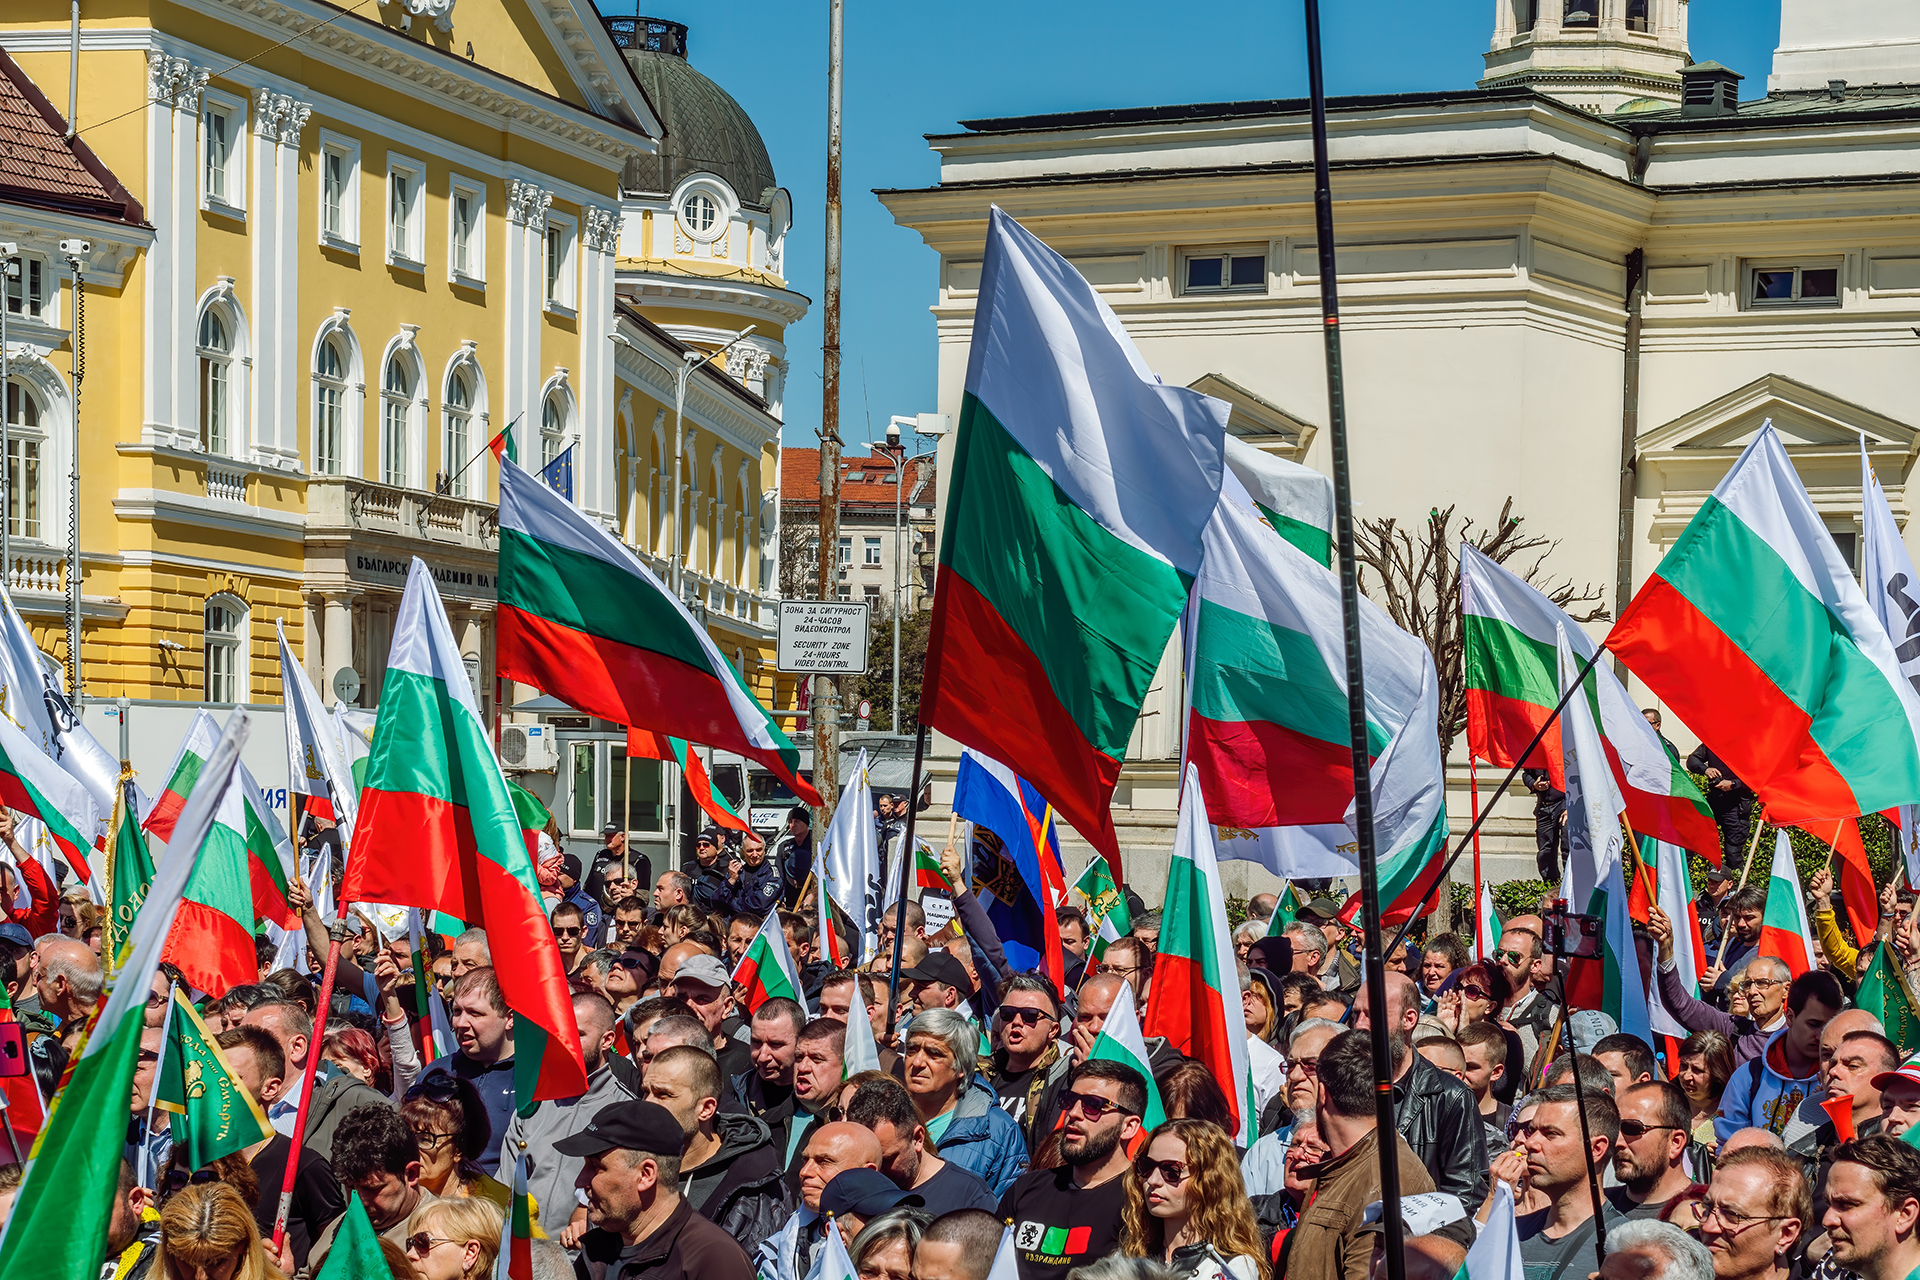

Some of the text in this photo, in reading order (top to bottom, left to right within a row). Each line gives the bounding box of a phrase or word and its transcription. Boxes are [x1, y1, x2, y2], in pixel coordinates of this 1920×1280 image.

[357, 556, 408, 576] БЪЛГАРСК
[429, 566, 472, 586] АДЕМИЯ
[477, 574, 489, 588] НА
[784, 606, 862, 616] ЗОНА ЗА СИГУРНОСТ
[803, 616, 843, 625] 24-ЧАСОВ
[794, 625, 851, 634] ВИДЕОКОНТРОЛ
[792, 641, 852, 650] SECURITY ZONE
[802, 650, 841, 659] 24-HOURS
[817, 660, 849, 668] CONTROL
[926, 912, 951, 920] НАЦИОН
[926, 920, 946, 928] КАТАС
